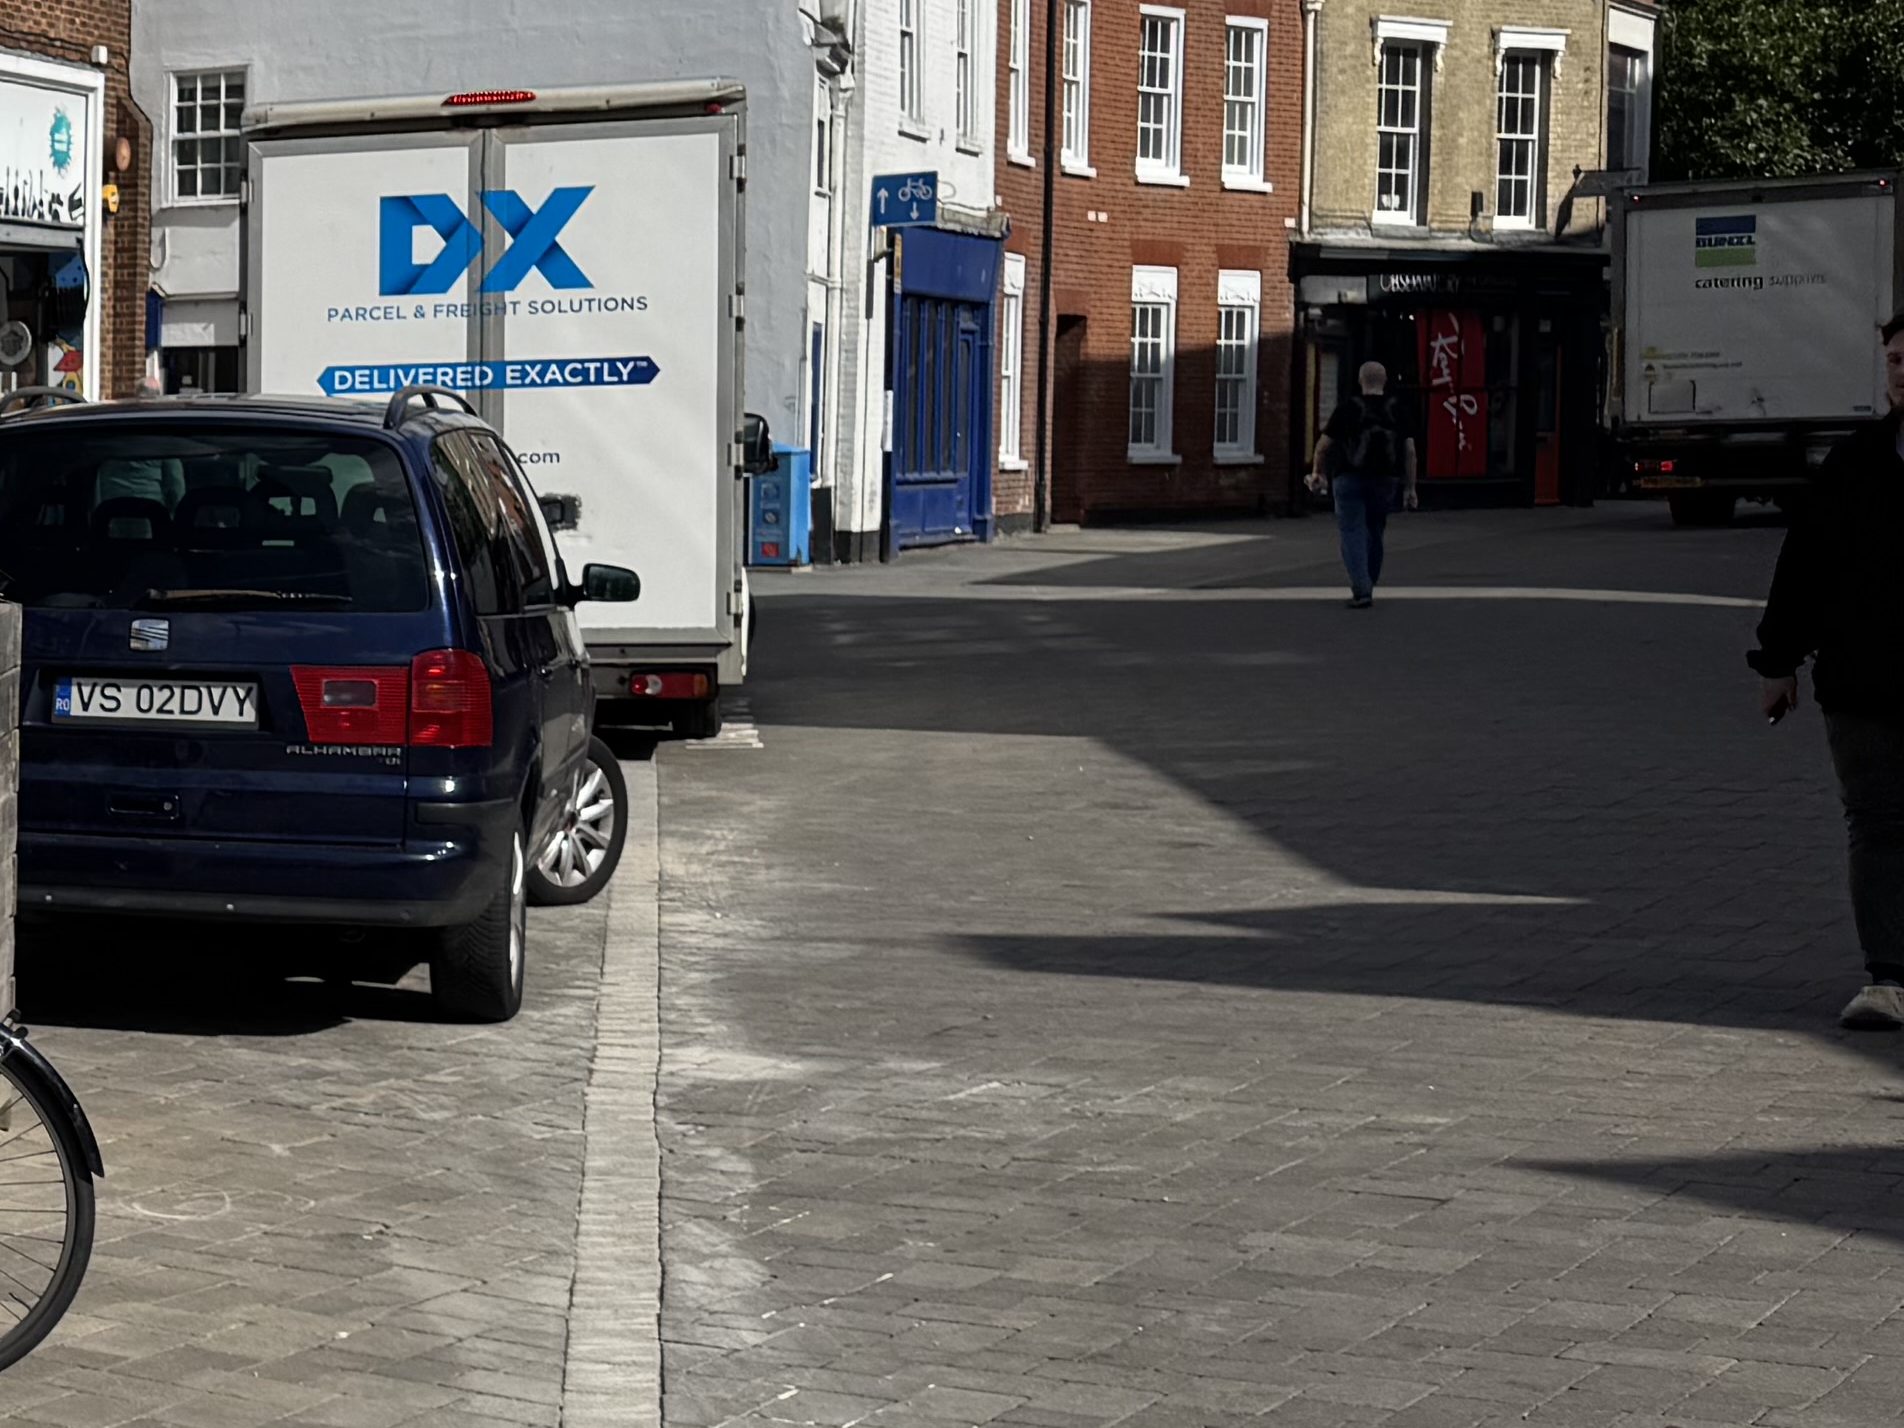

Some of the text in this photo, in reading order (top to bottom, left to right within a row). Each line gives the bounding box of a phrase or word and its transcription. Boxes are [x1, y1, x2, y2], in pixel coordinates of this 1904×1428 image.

[379, 185, 596, 296] DX
[1695, 275, 1763, 290] catering
[327, 296, 648, 322] PARCEL & FREIGHT SOLUTIONS
[333, 365, 494, 391] DELIVERED
[56, 682, 253, 717] RO VS 02DVY
[286, 745, 401, 756] ALHAMBRA
